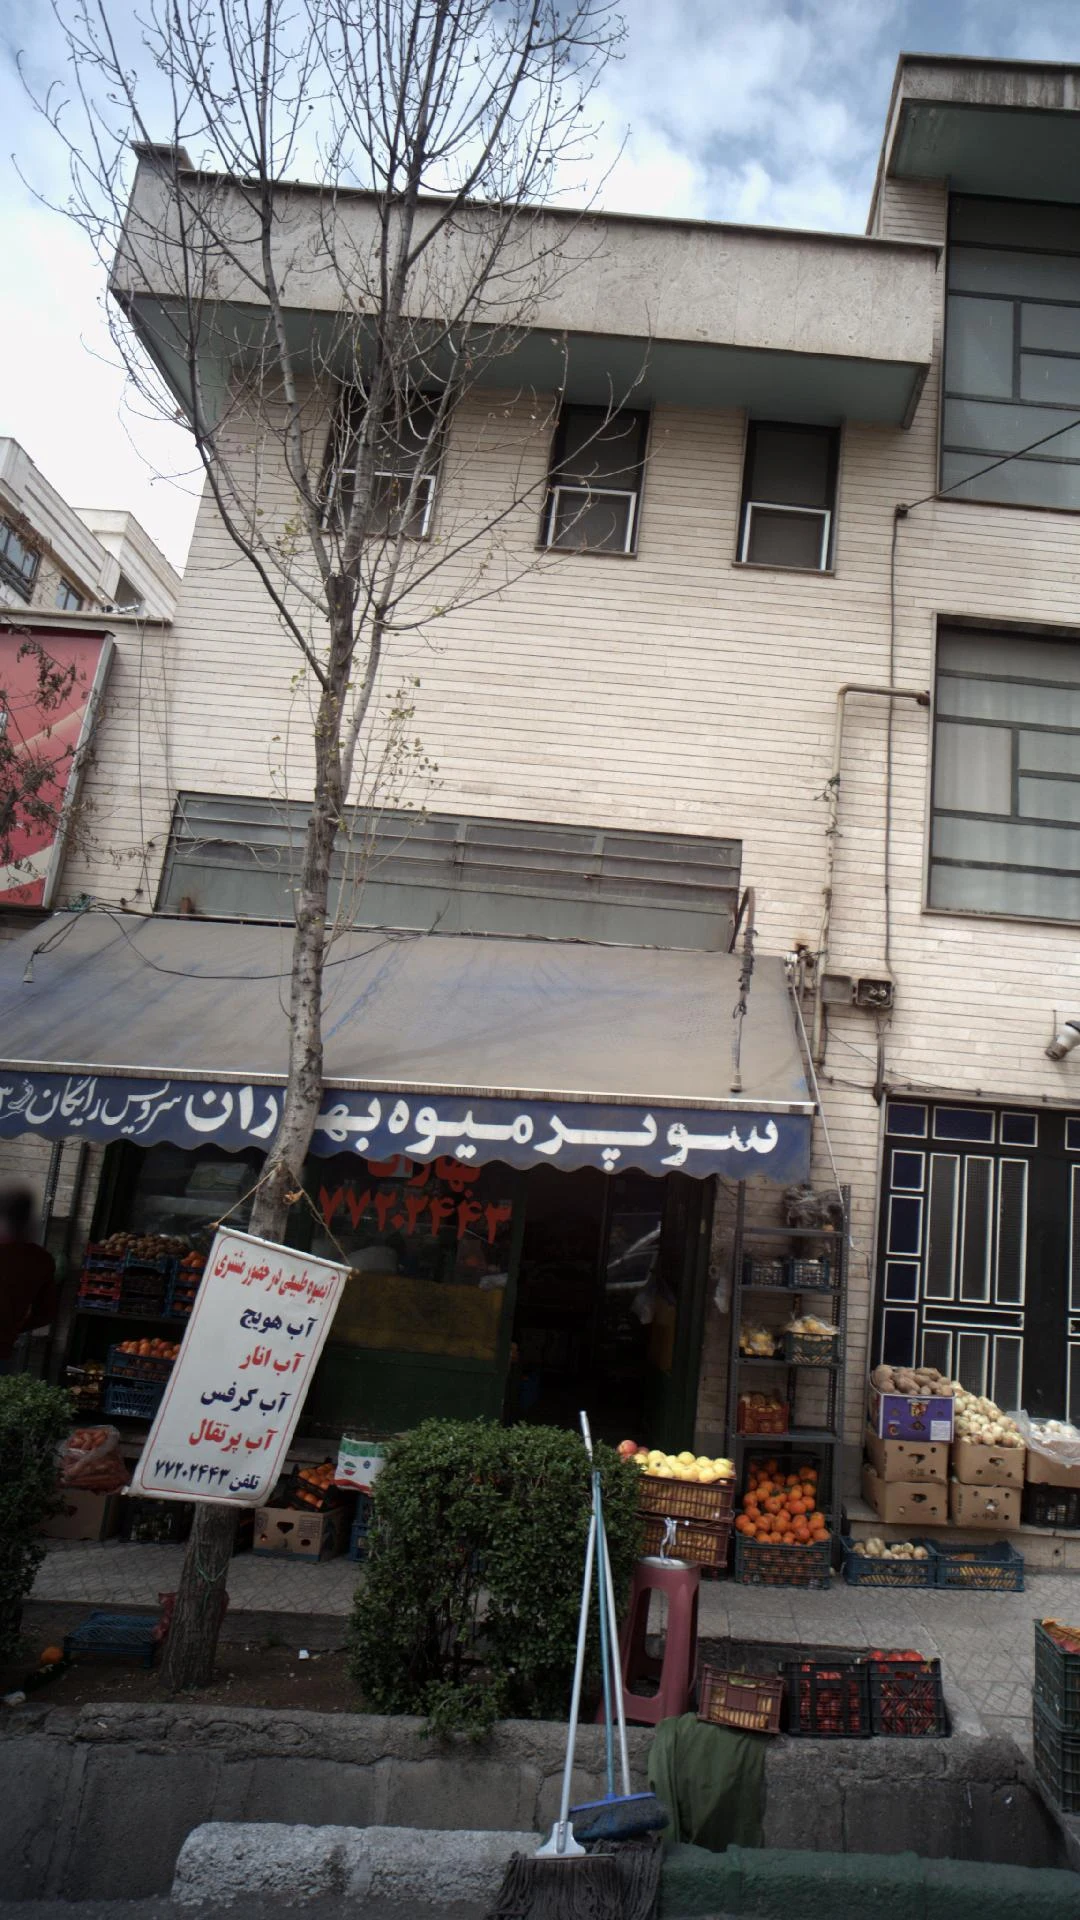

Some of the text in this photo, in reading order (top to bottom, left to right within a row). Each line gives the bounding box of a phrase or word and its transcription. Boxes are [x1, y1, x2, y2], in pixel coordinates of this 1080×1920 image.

[25, 1076, 101, 1127] رایگان
[100, 1080, 182, 1135] سرویس
[184, 1085, 382, 1152] بهران
[387, 1100, 534, 1159] میوه
[533, 1112, 779, 1171] سوپر
[319, 1184, 513, 1246] ۷۷۲۰۲۴۴۳
[214, 1251, 246, 1279] مشتری
[241, 1258, 270, 1286] حضور
[265, 1267, 282, 1292] در
[278, 1268, 308, 1296] طبیعی
[239, 1307, 318, 1339] آب هویج
[238, 1345, 305, 1377] آب انار
[200, 1381, 292, 1417] آب کرفس
[188, 1418, 278, 1454] آب پرتقال
[153, 1459, 261, 1492] تلفن ۷۷۲۰۲۴۴۳
